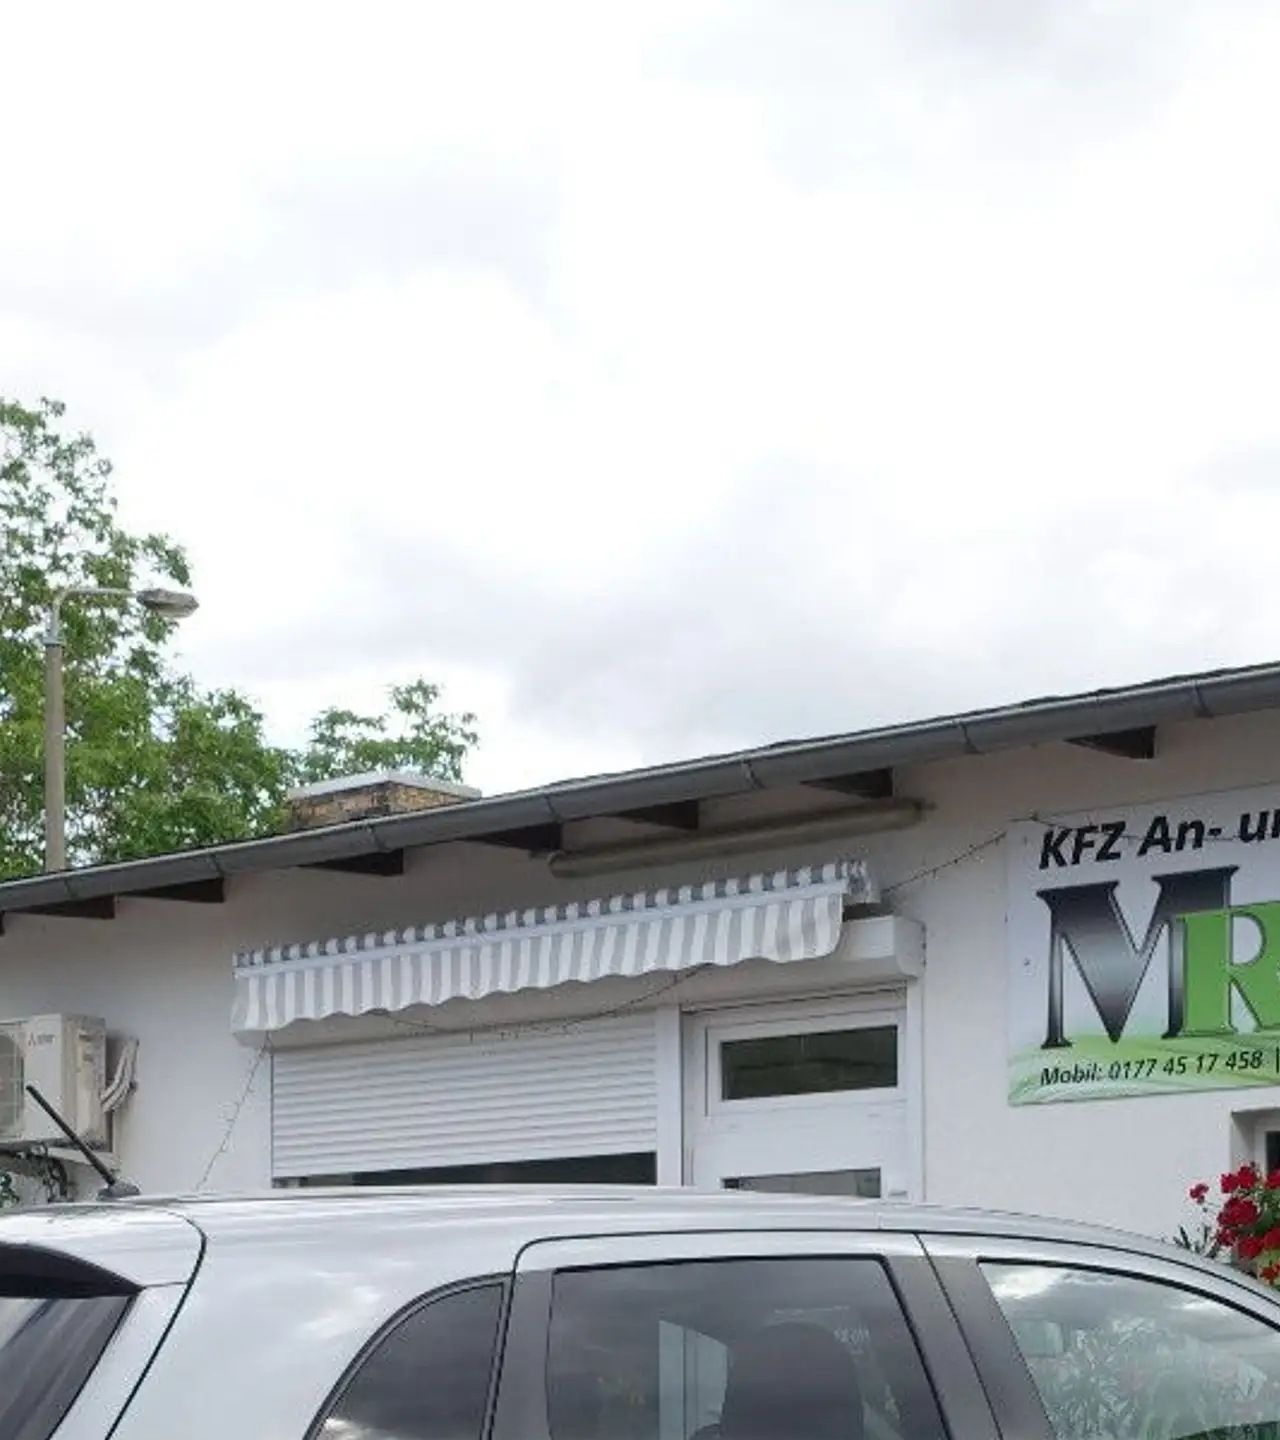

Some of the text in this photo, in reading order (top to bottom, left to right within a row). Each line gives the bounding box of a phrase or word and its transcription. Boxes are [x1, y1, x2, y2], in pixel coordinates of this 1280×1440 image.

[1038, 820, 1127, 870] KFZ
[1138, 815, 1222, 858] An-
[1040, 1062, 1102, 1087] Mobil:
[1107, 1057, 1158, 1082] 0177
[1162, 1055, 1188, 1077] 45
[1195, 1052, 1218, 1075] 17
[1224, 1050, 1264, 1071] 458
